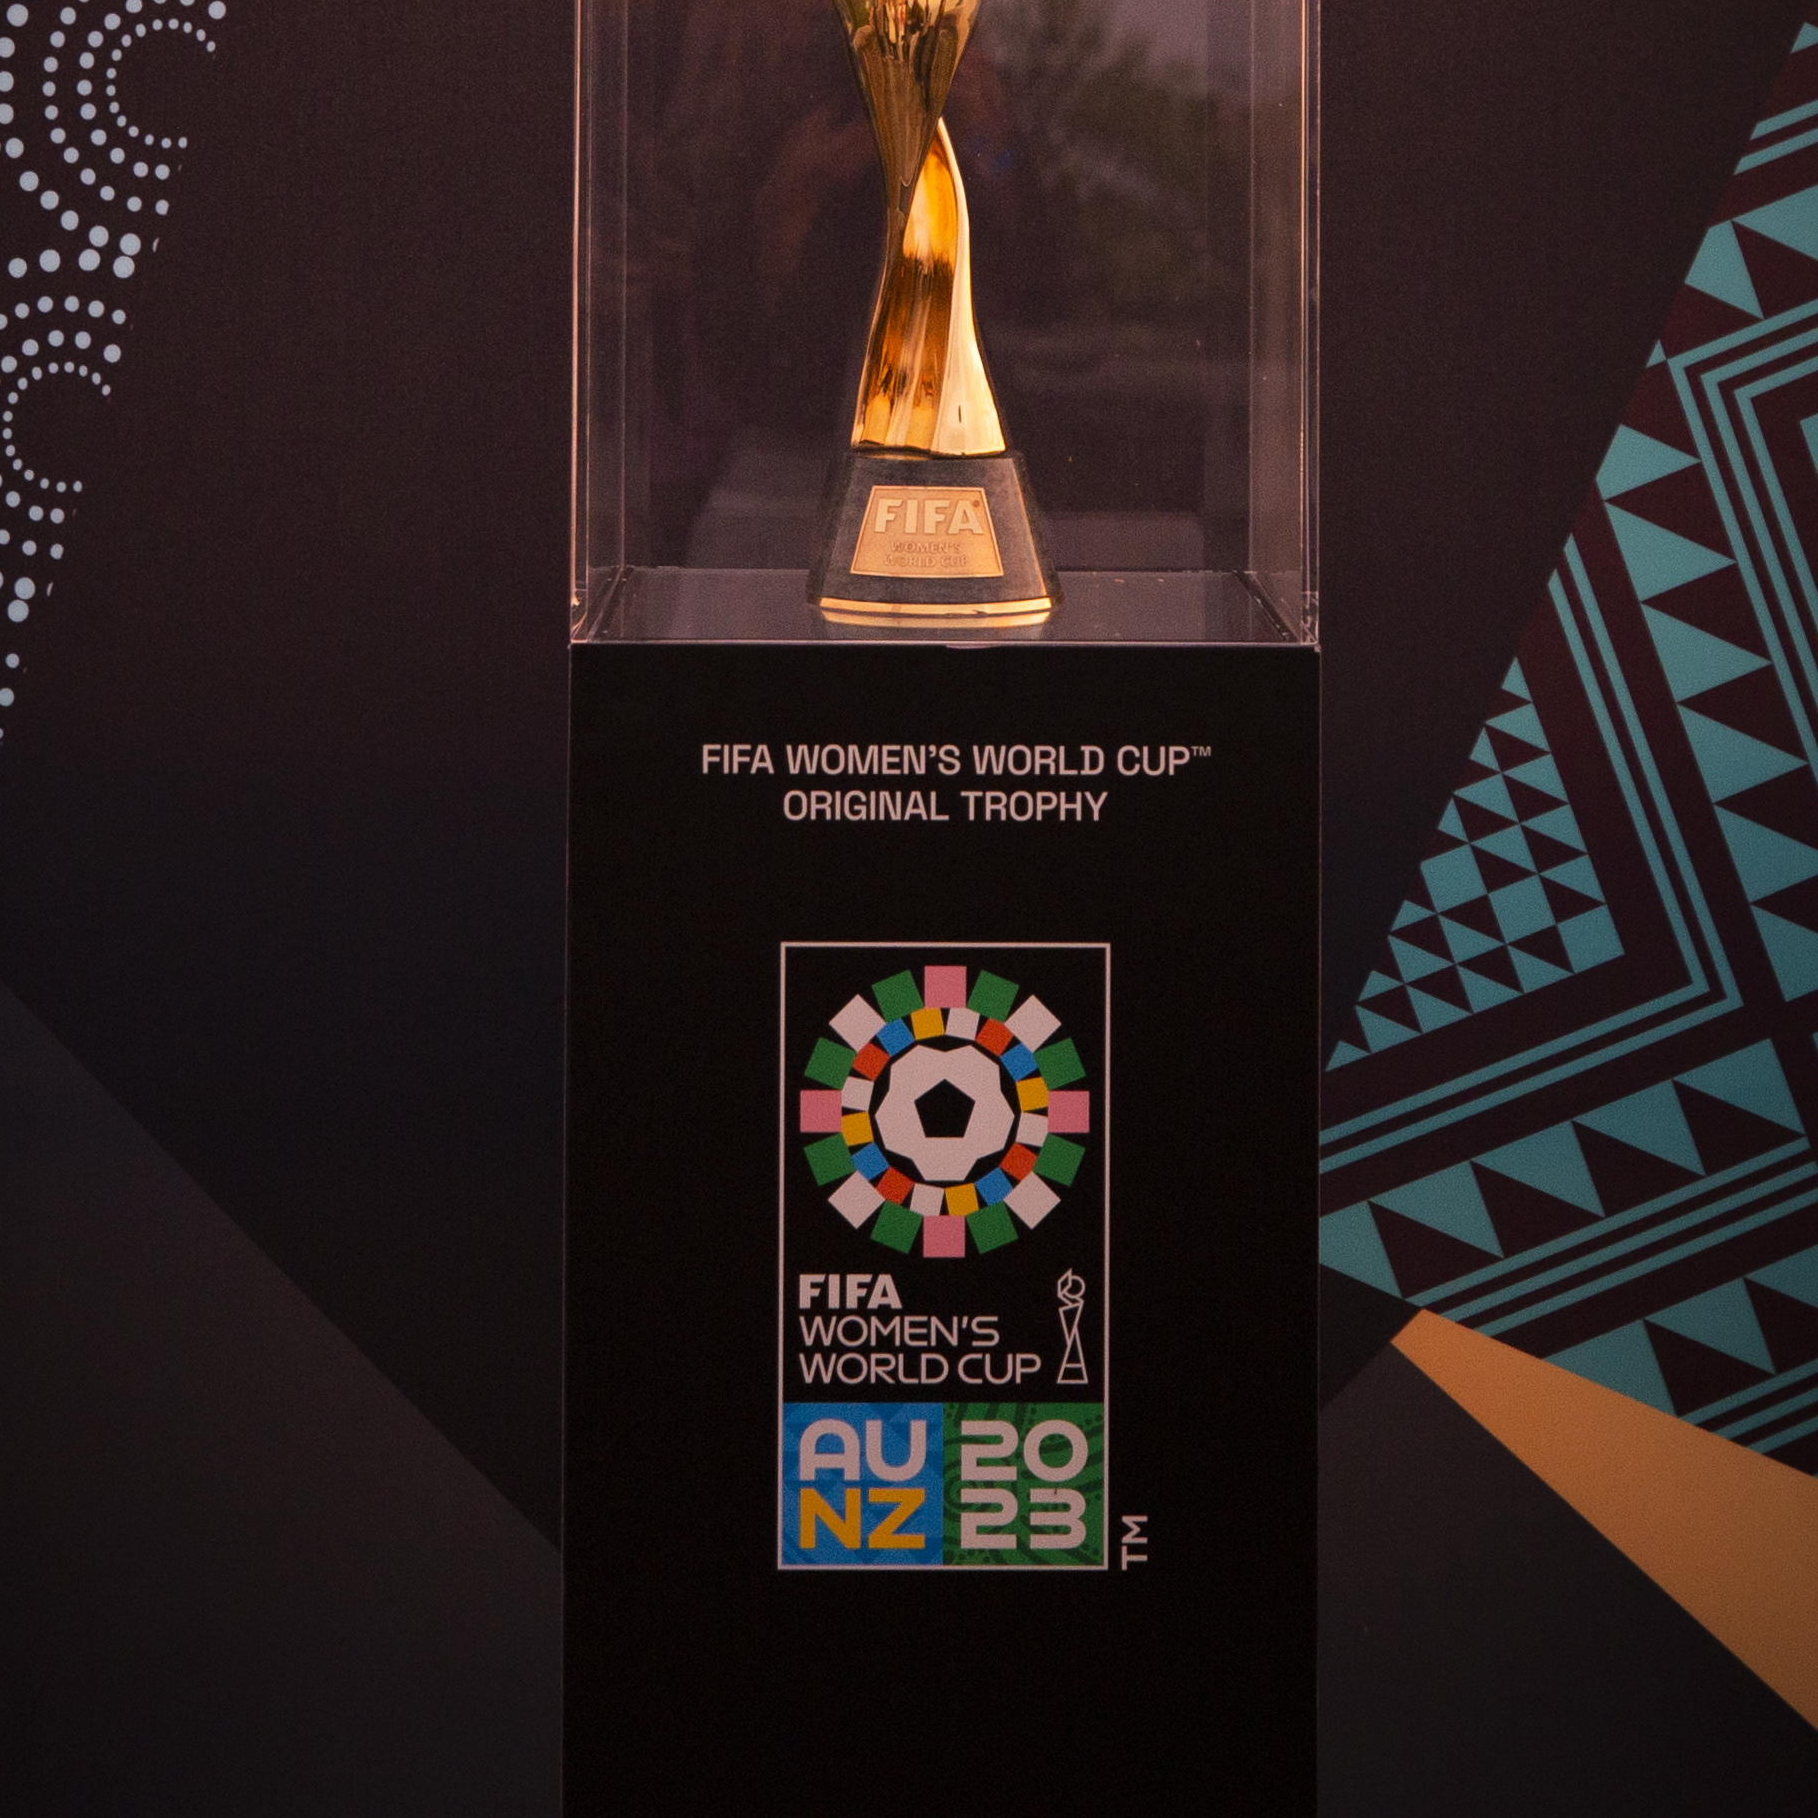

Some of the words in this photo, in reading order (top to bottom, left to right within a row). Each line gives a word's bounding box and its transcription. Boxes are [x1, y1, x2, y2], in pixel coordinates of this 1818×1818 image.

[873, 497, 984, 535] FIFA
[883, 554, 936, 568] WORLD
[940, 556, 969, 568] CUP
[890, 541, 963, 554] WOMEN'S
[702, 743, 775, 775] FIFA
[786, 743, 961, 776] WOMEN'S
[972, 744, 1105, 777] WORLD
[783, 789, 950, 822] ORIGINAL
[960, 790, 1109, 822] TROPHY
[799, 1273, 903, 1309] FIFA
[799, 1315, 1000, 1347] WOMEN'S
[799, 1352, 949, 1384] WORLD
[957, 1353, 1042, 1385] CUP
[798, 1418, 927, 1482] AU
[960, 1419, 1089, 1482] 20
[799, 1486, 926, 1550] NZ
[960, 1487, 1087, 1550] 23
